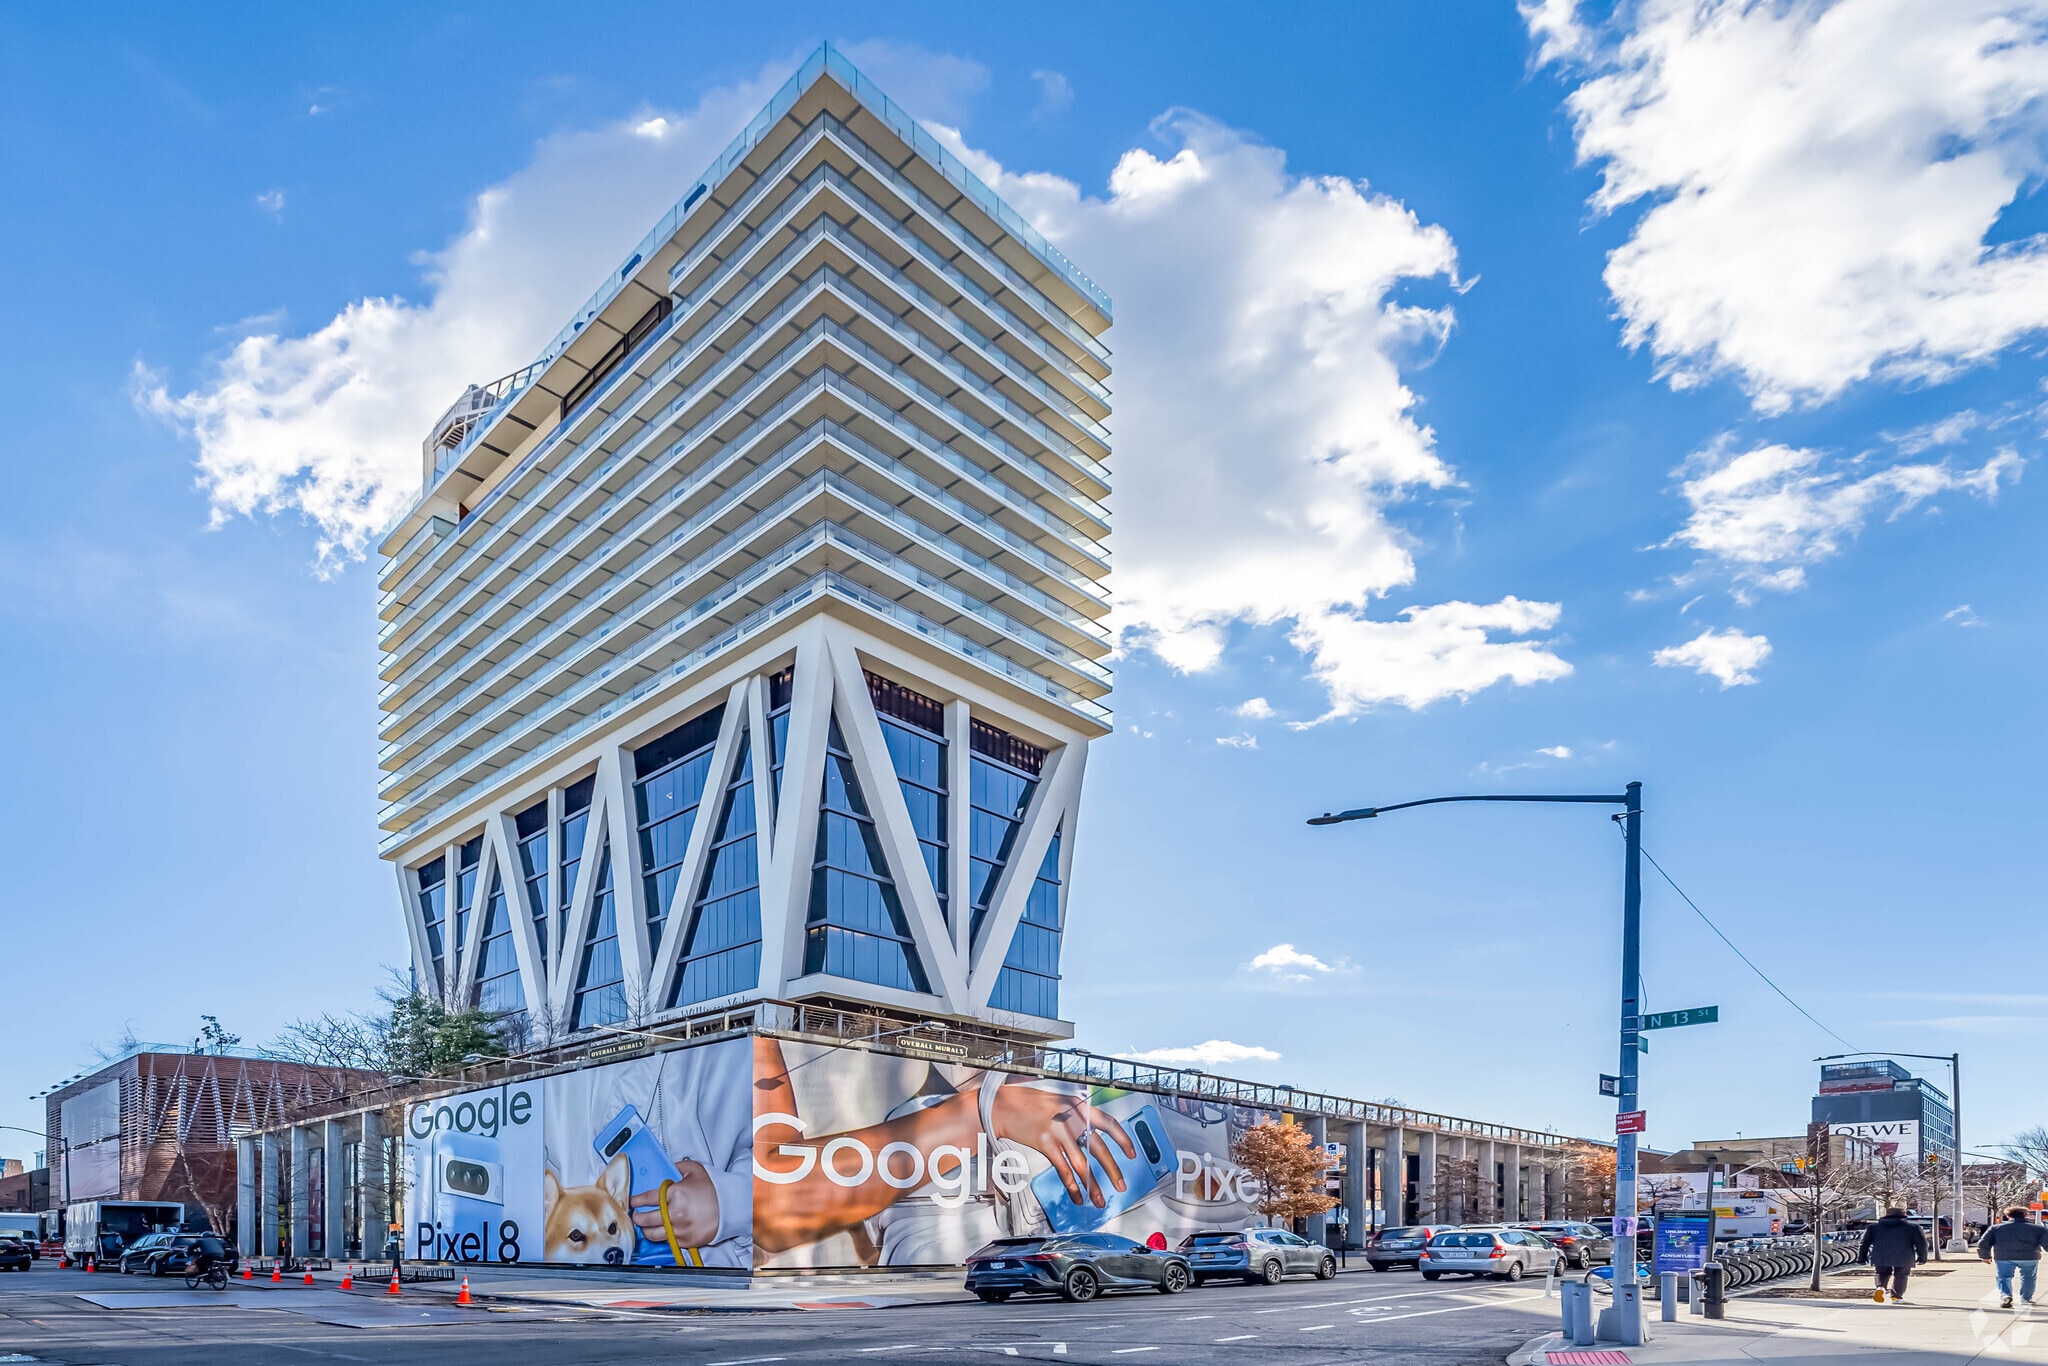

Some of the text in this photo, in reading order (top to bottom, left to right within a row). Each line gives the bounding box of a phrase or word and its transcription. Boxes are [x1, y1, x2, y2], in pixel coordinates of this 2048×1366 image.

[1650, 1009, 1709, 1028] N 13 St
[591, 1041, 643, 1058] OVERALL MURALS
[901, 1039, 964, 1055] OVERALL MURALS
[409, 1085, 532, 1140] Google
[1835, 1122, 1912, 1137] OEWE
[753, 1112, 1030, 1209] Google
[1176, 1149, 1261, 1204] Pixe
[417, 1219, 521, 1263] Pixel 8
